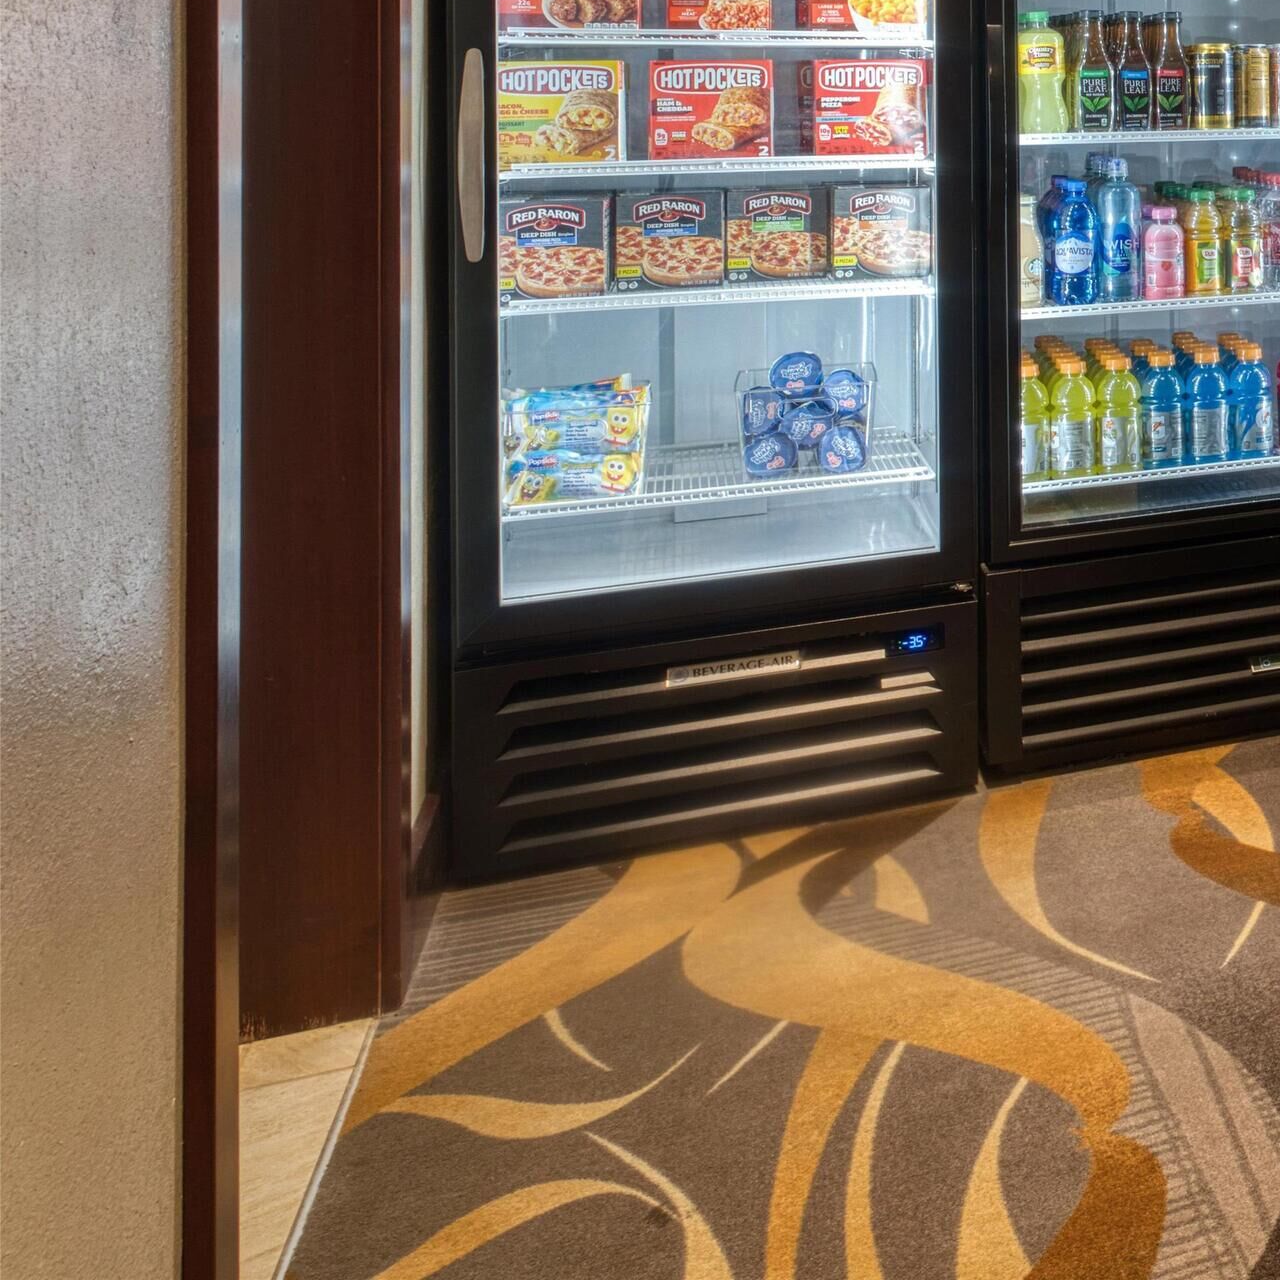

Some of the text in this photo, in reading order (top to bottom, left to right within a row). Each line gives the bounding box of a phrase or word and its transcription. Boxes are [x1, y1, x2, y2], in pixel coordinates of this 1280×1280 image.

[501, 68, 609, 91] HOT POCKETS
[660, 68, 762, 90] HOT POCKETS
[824, 67, 918, 89] HOT POCKETS
[1082, 78, 1107, 87] PURE
[638, 200, 700, 217] RED BARON
[749, 195, 806, 210] RED BARON
[854, 193, 910, 209] RED BARON
[511, 208, 580, 225] RED BARON
[692, 654, 794, 678] BEVERAGE-AIR
